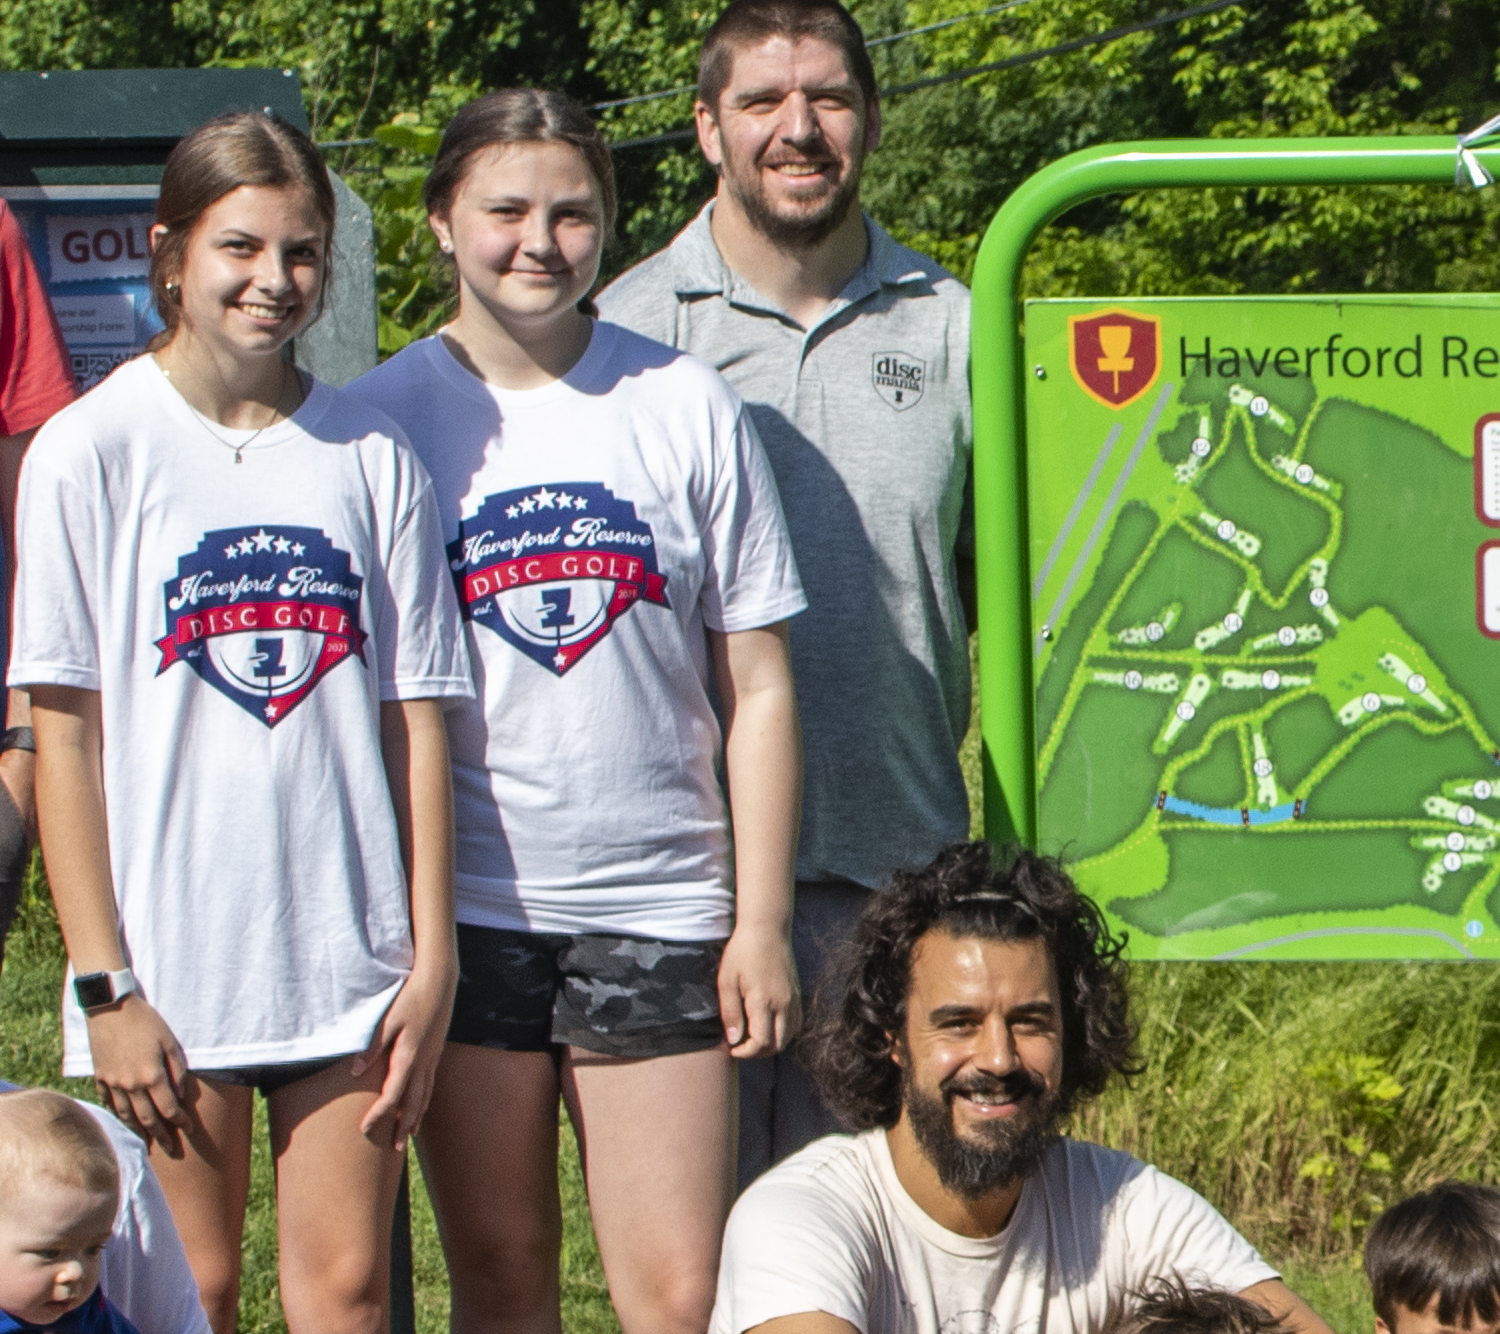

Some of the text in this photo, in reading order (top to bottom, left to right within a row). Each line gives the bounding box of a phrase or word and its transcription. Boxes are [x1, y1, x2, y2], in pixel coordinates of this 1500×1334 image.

[876, 357, 922, 381] disc
[1179, 334, 1422, 379] Haverford
[451, 517, 653, 571] Haverford Reserve
[168, 566, 359, 611] Haverford Reserve
[472, 555, 639, 598] DISC GOLF
[189, 606, 350, 639] DISC GOLF
